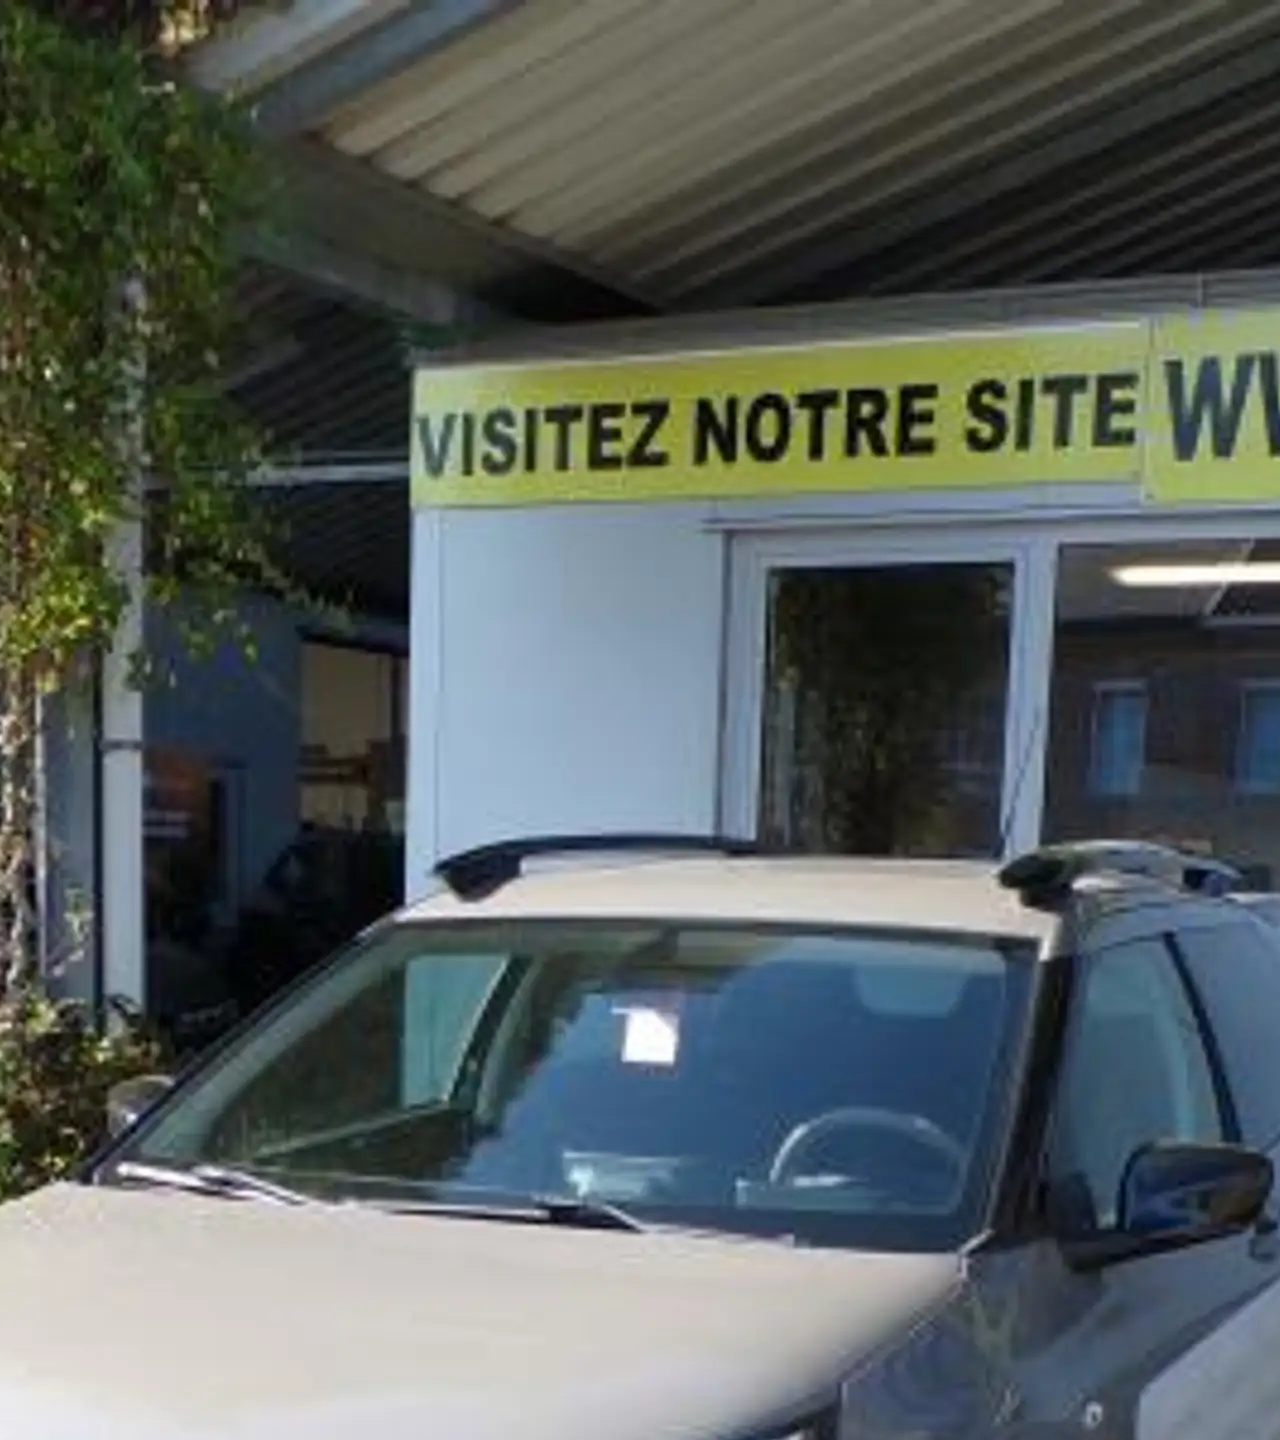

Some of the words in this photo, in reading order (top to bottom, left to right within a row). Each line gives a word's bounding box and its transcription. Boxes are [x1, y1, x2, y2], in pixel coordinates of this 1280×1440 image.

[415, 399, 670, 476] VISITEZ
[693, 384, 938, 466] NOTRE
[965, 374, 1137, 453] SITE
